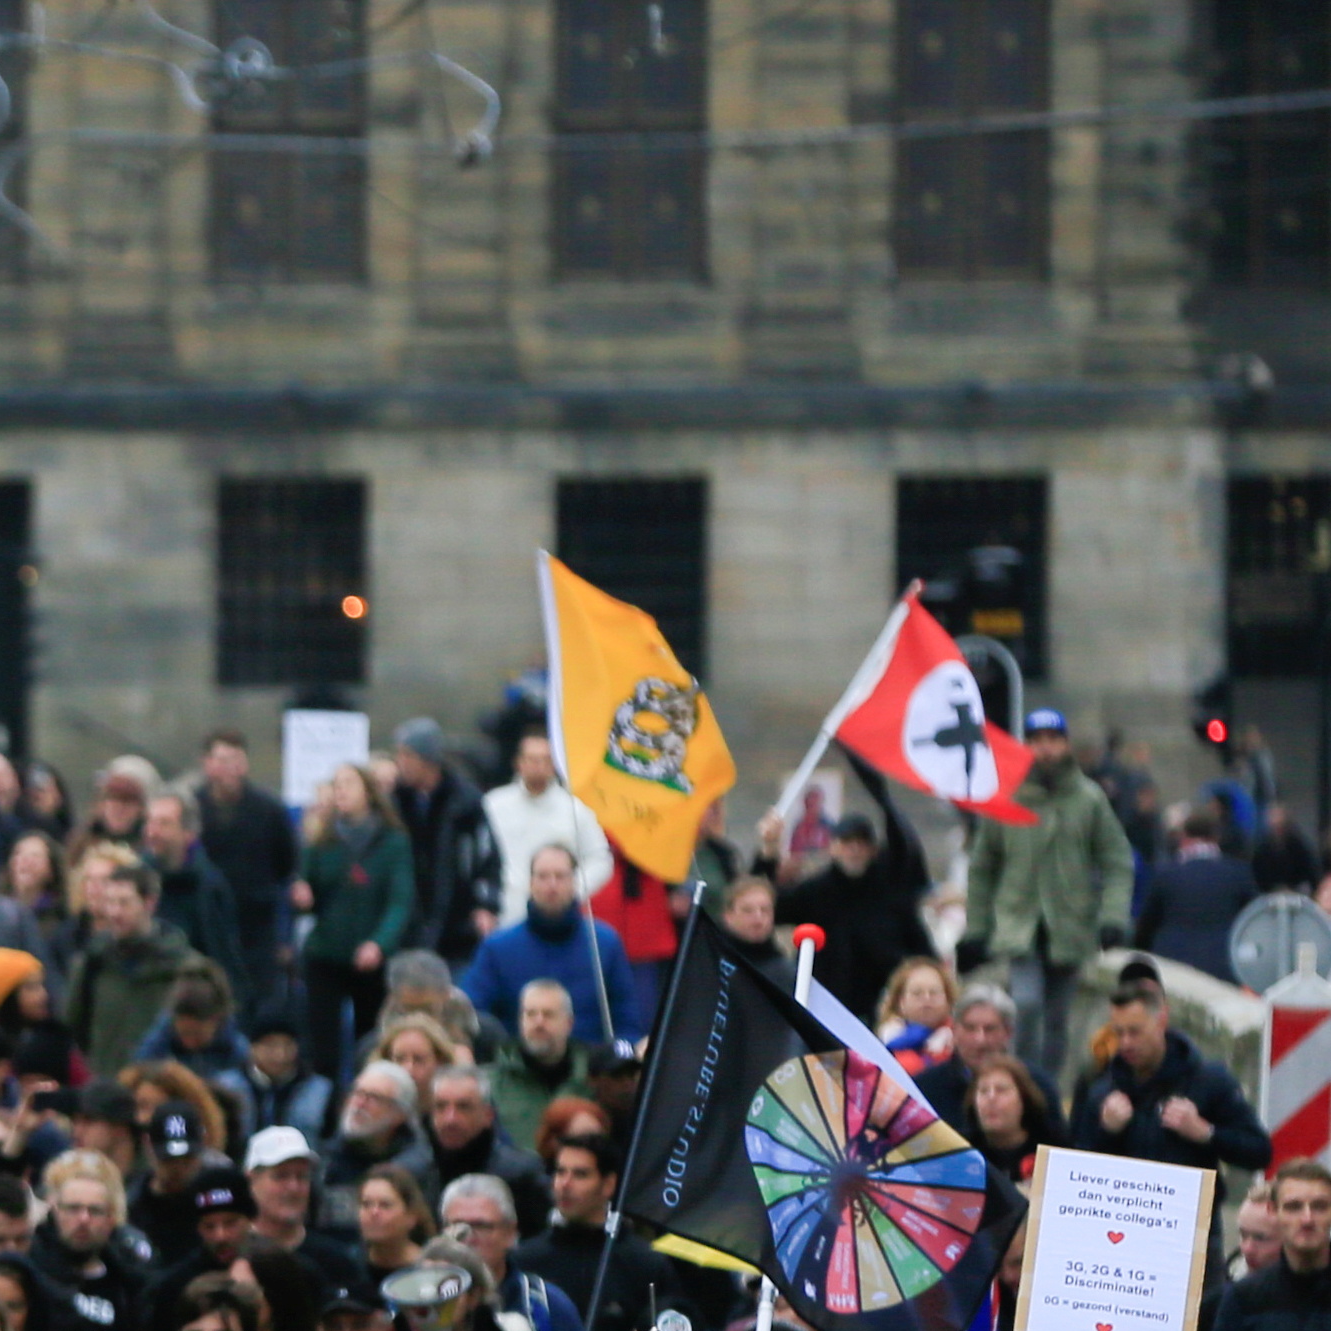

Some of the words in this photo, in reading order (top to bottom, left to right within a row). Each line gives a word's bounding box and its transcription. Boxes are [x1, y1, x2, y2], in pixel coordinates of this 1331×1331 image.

[1069, 1170, 1110, 1187] Liever
[1113, 1177, 1176, 1197] geschikte
[1078, 1189, 1103, 1202] dan
[1106, 1194, 1163, 1212] verplicht
[1058, 1203, 1112, 1220] geprikte
[1115, 1212, 1178, 1230] collega's!
[1065, 1260, 1088, 1274] 3G,
[1091, 1263, 1111, 1277] 2G
[1113, 1266, 1124, 1279] &
[1128, 1269, 1146, 1282] 1G
[1064, 1275, 1155, 1298] Discriminatie!
[1072, 1300, 1113, 1314] gezond
[1114, 1304, 1170, 1324] (verstand)
